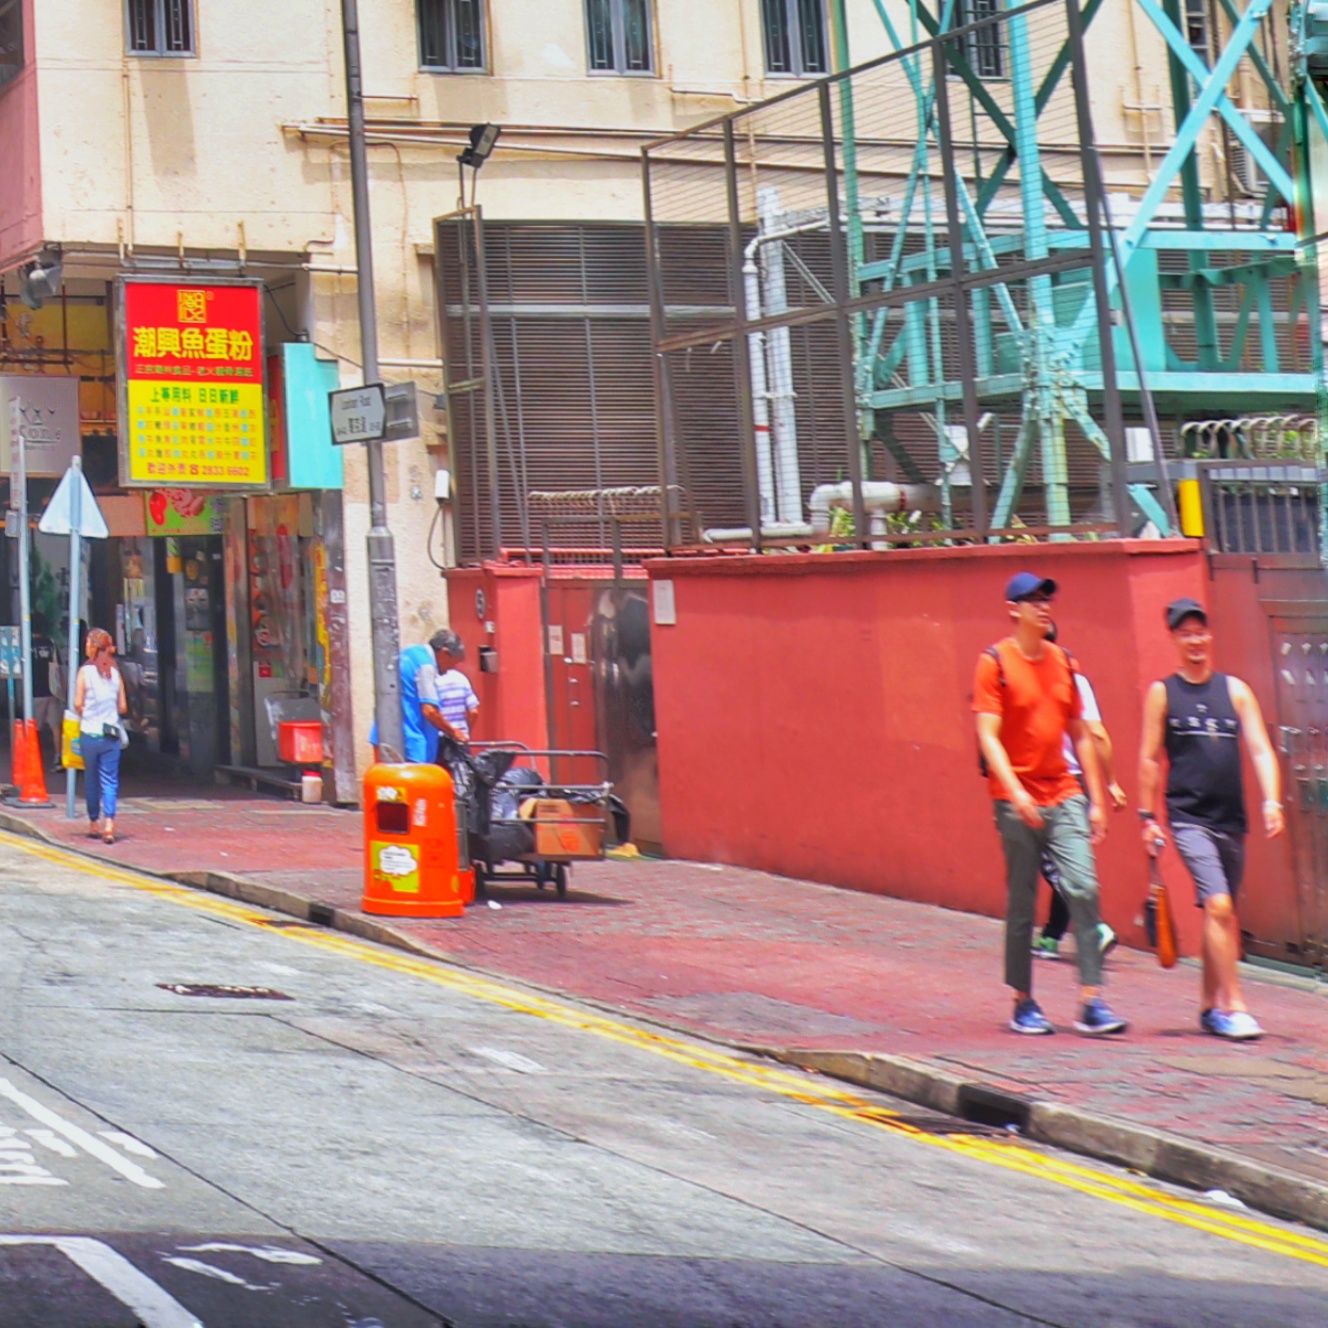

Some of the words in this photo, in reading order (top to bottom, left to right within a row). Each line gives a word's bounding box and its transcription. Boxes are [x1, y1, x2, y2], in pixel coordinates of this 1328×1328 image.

[132, 327, 254, 361] 潮興魚蛋粉
